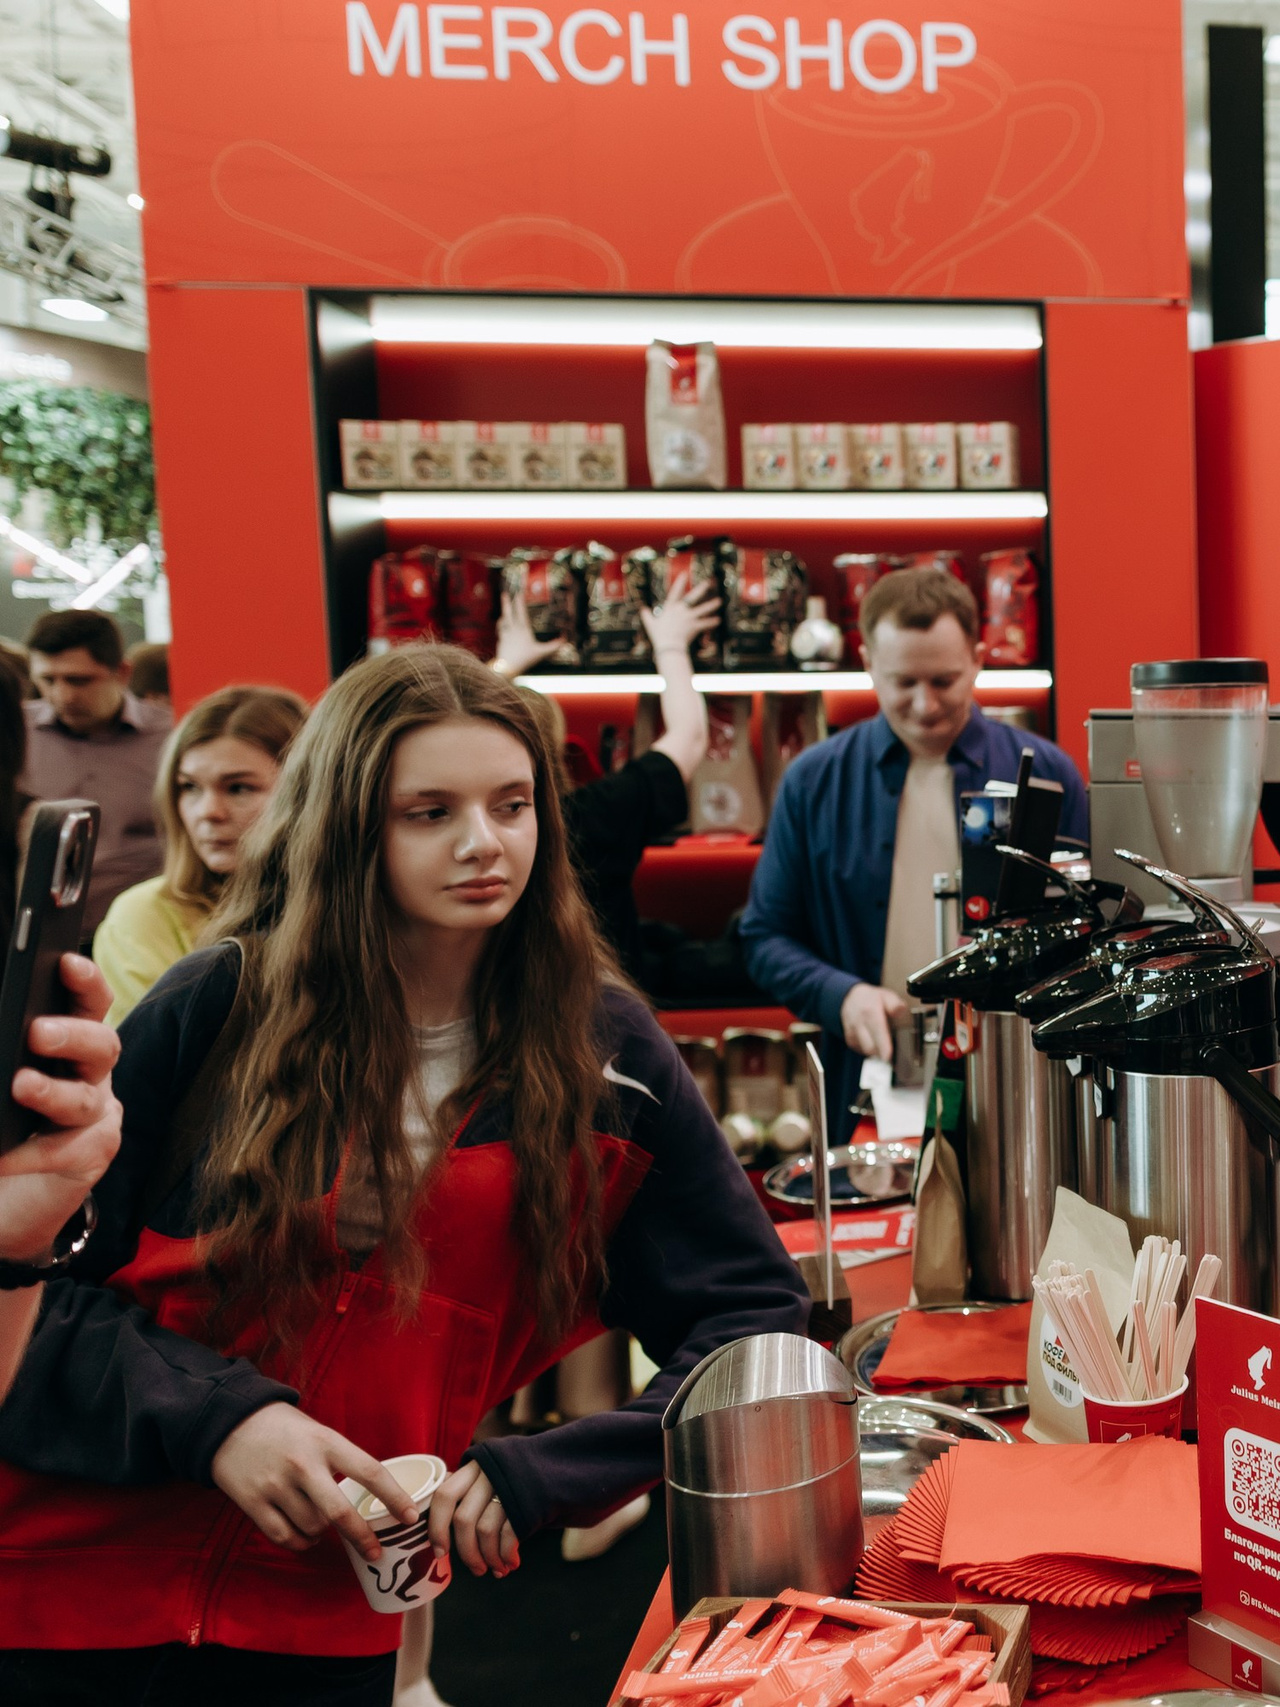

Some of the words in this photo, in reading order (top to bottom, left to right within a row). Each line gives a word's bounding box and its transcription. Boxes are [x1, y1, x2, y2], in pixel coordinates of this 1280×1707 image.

[345, 0, 692, 88] MERCH
[721, 14, 978, 94] SHOP
[1044, 1340, 1064, 1360] КОФЕ
[1043, 1350, 1056, 1369] ПОД
[1231, 1384, 1259, 1402] Julius
[1233, 1550, 1246, 1564] по
[679, 1669, 719, 1681] Julius
[721, 1668, 758, 1677] Meinl
